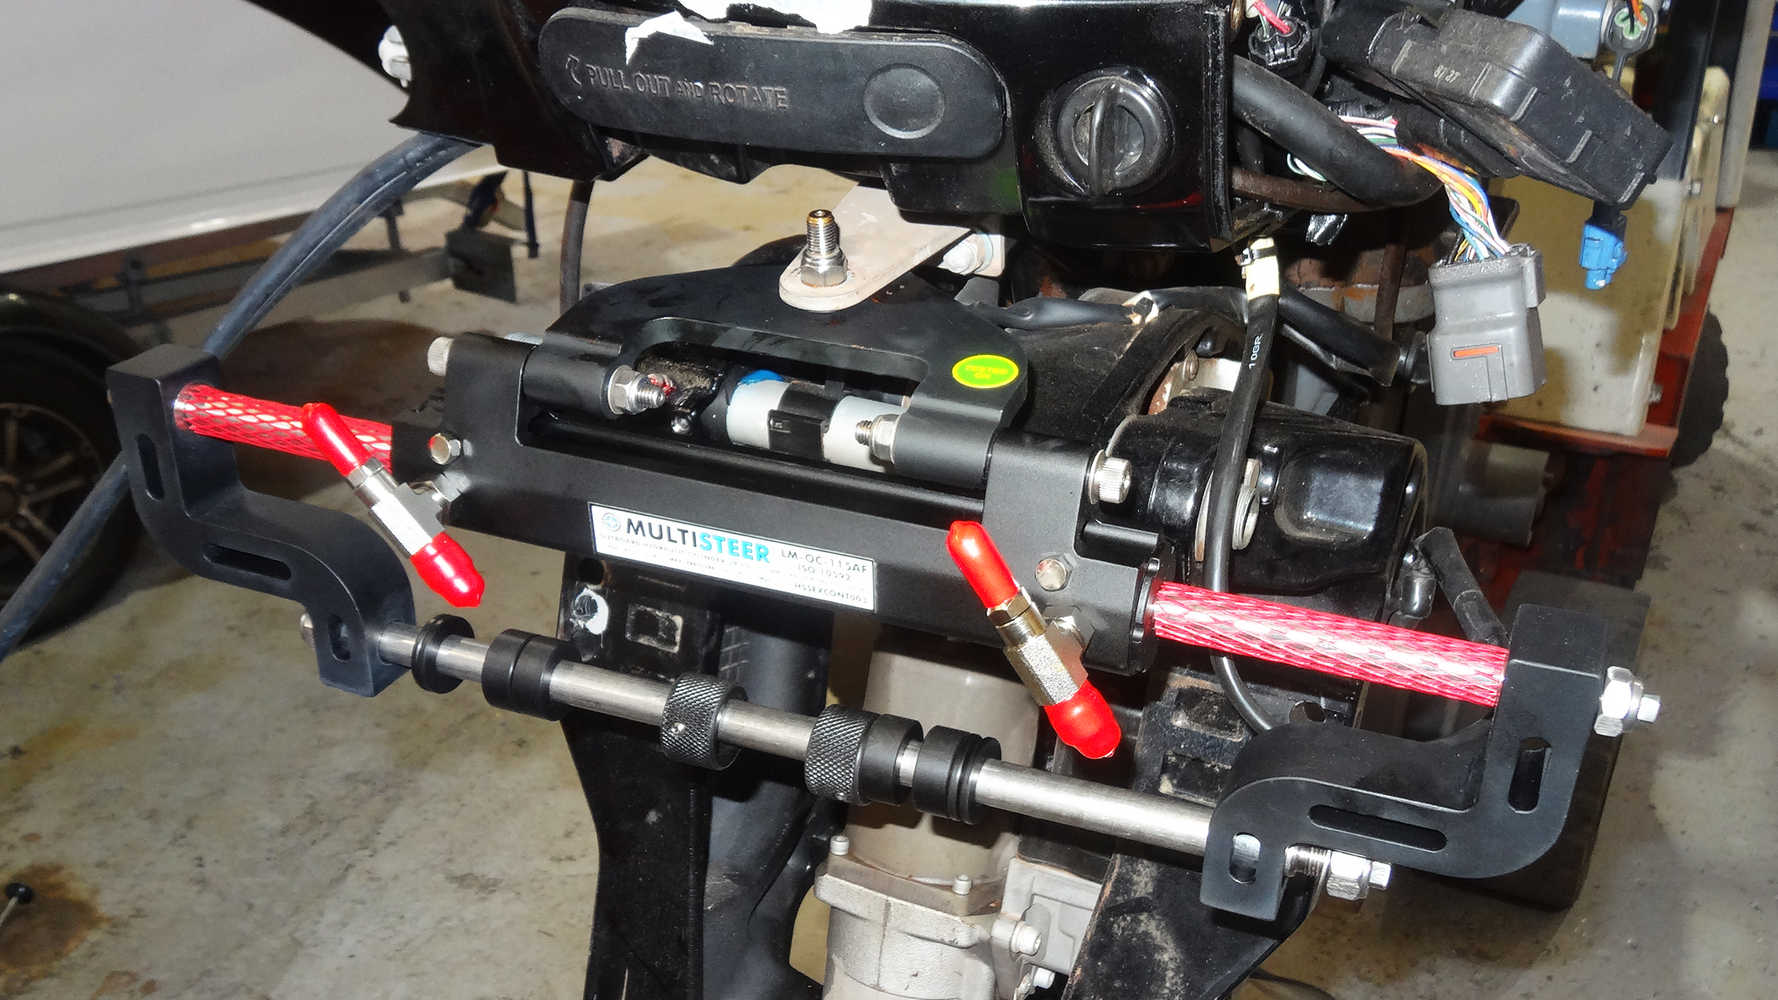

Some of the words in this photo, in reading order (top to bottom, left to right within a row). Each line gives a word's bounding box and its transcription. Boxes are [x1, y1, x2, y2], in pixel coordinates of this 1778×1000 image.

[586, 63, 631, 90] PULL
[633, 71, 670, 97] OUT
[676, 79, 703, 98] AND
[708, 82, 790, 109] ROTATE
[626, 518, 770, 563] MULTISTEER
